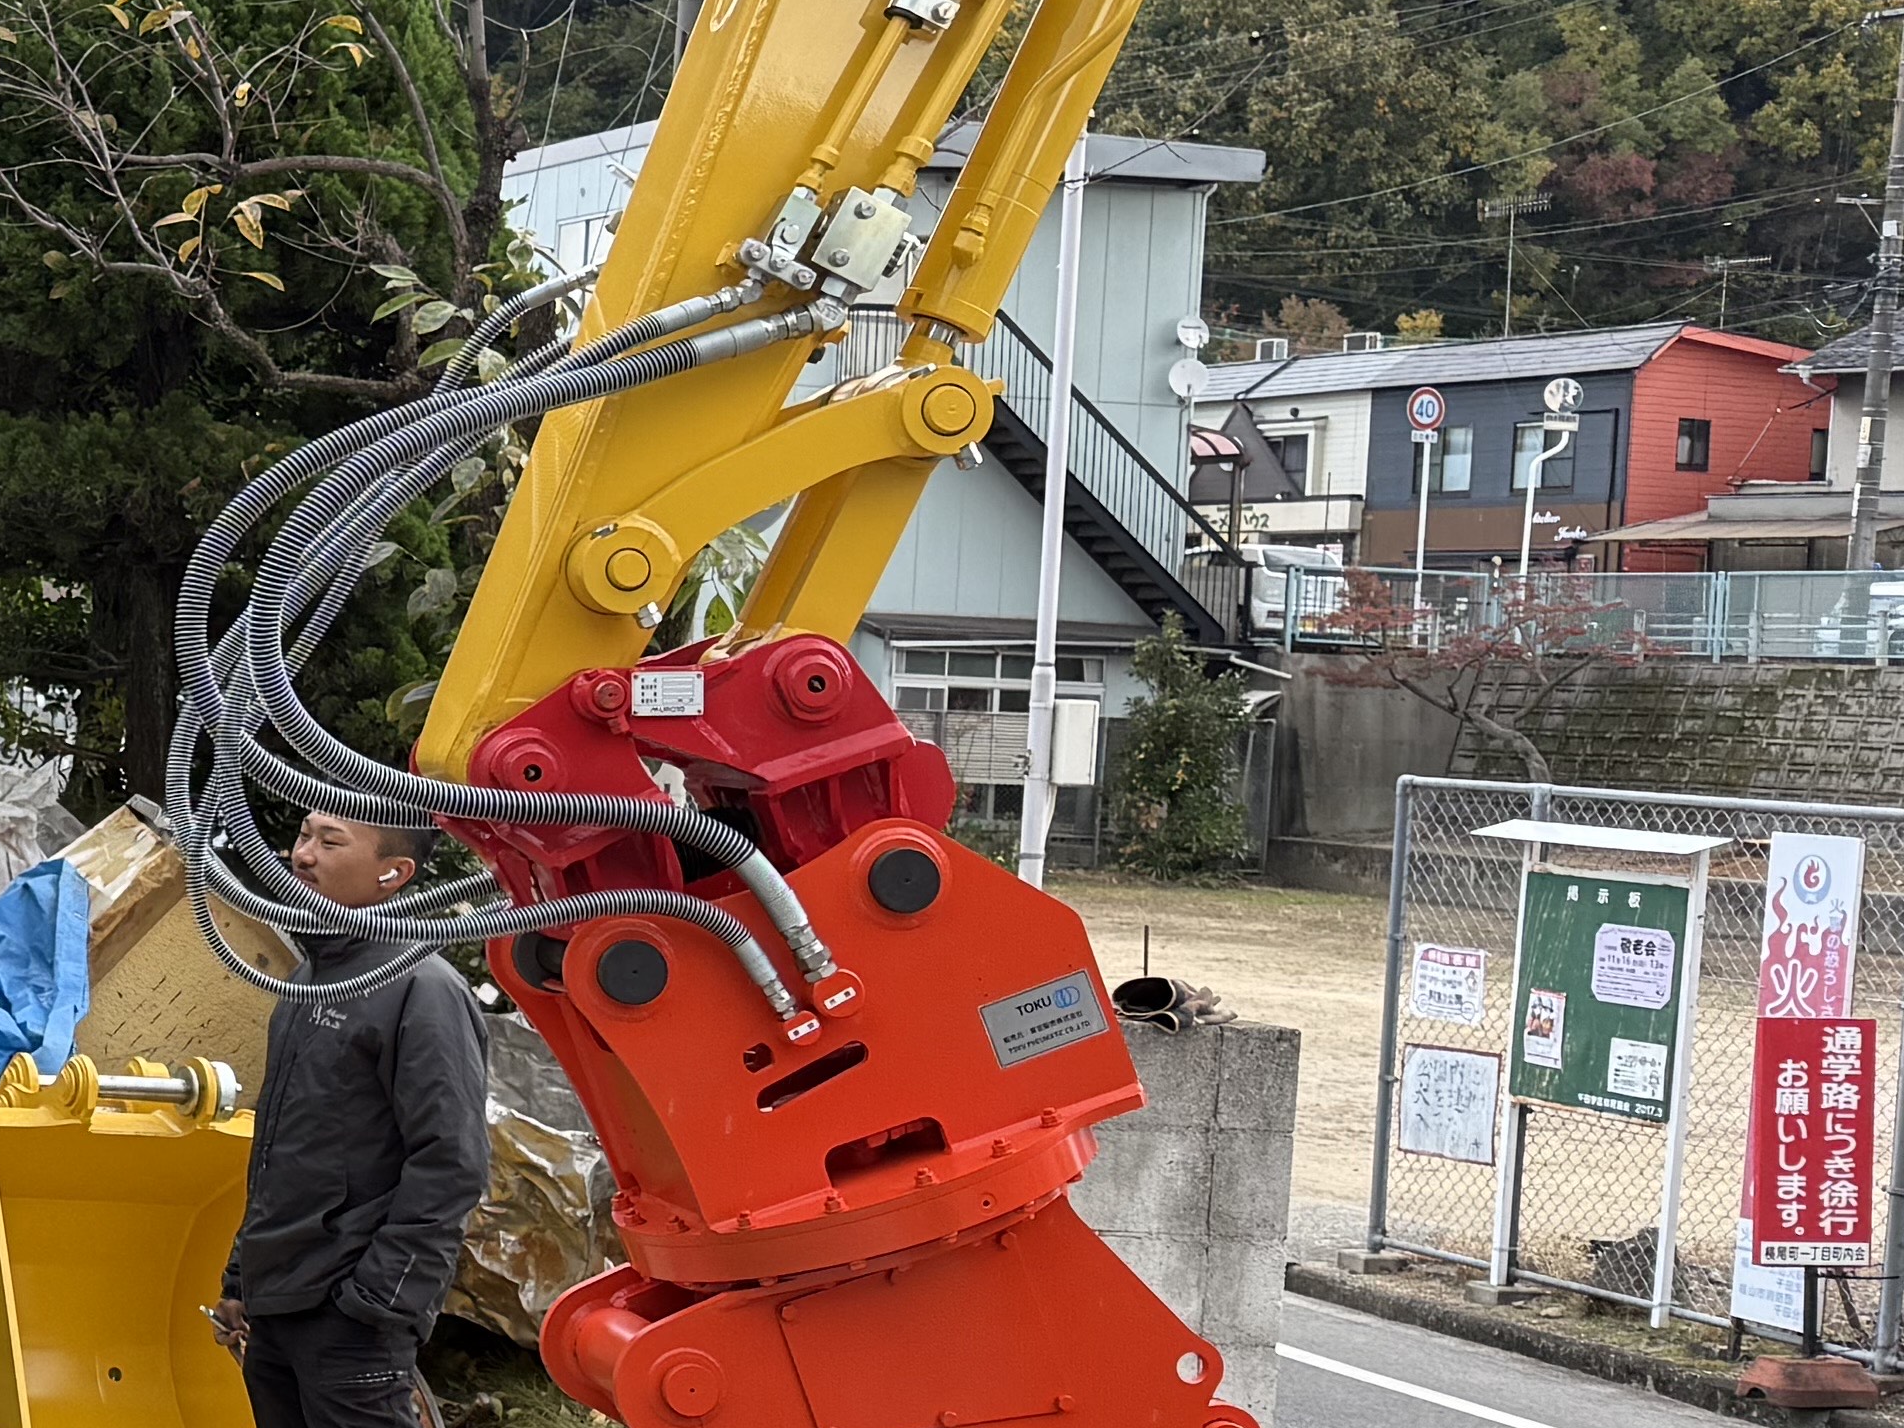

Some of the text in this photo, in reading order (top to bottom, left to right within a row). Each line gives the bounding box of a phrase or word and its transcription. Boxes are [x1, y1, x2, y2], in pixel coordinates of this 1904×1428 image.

[1416, 400, 1435, 418] 40
[1015, 995, 1052, 1017] TOKU
[1775, 1059, 1810, 1237] お願いします。
[1818, 1026, 1862, 1237] 通学路につき徐行
